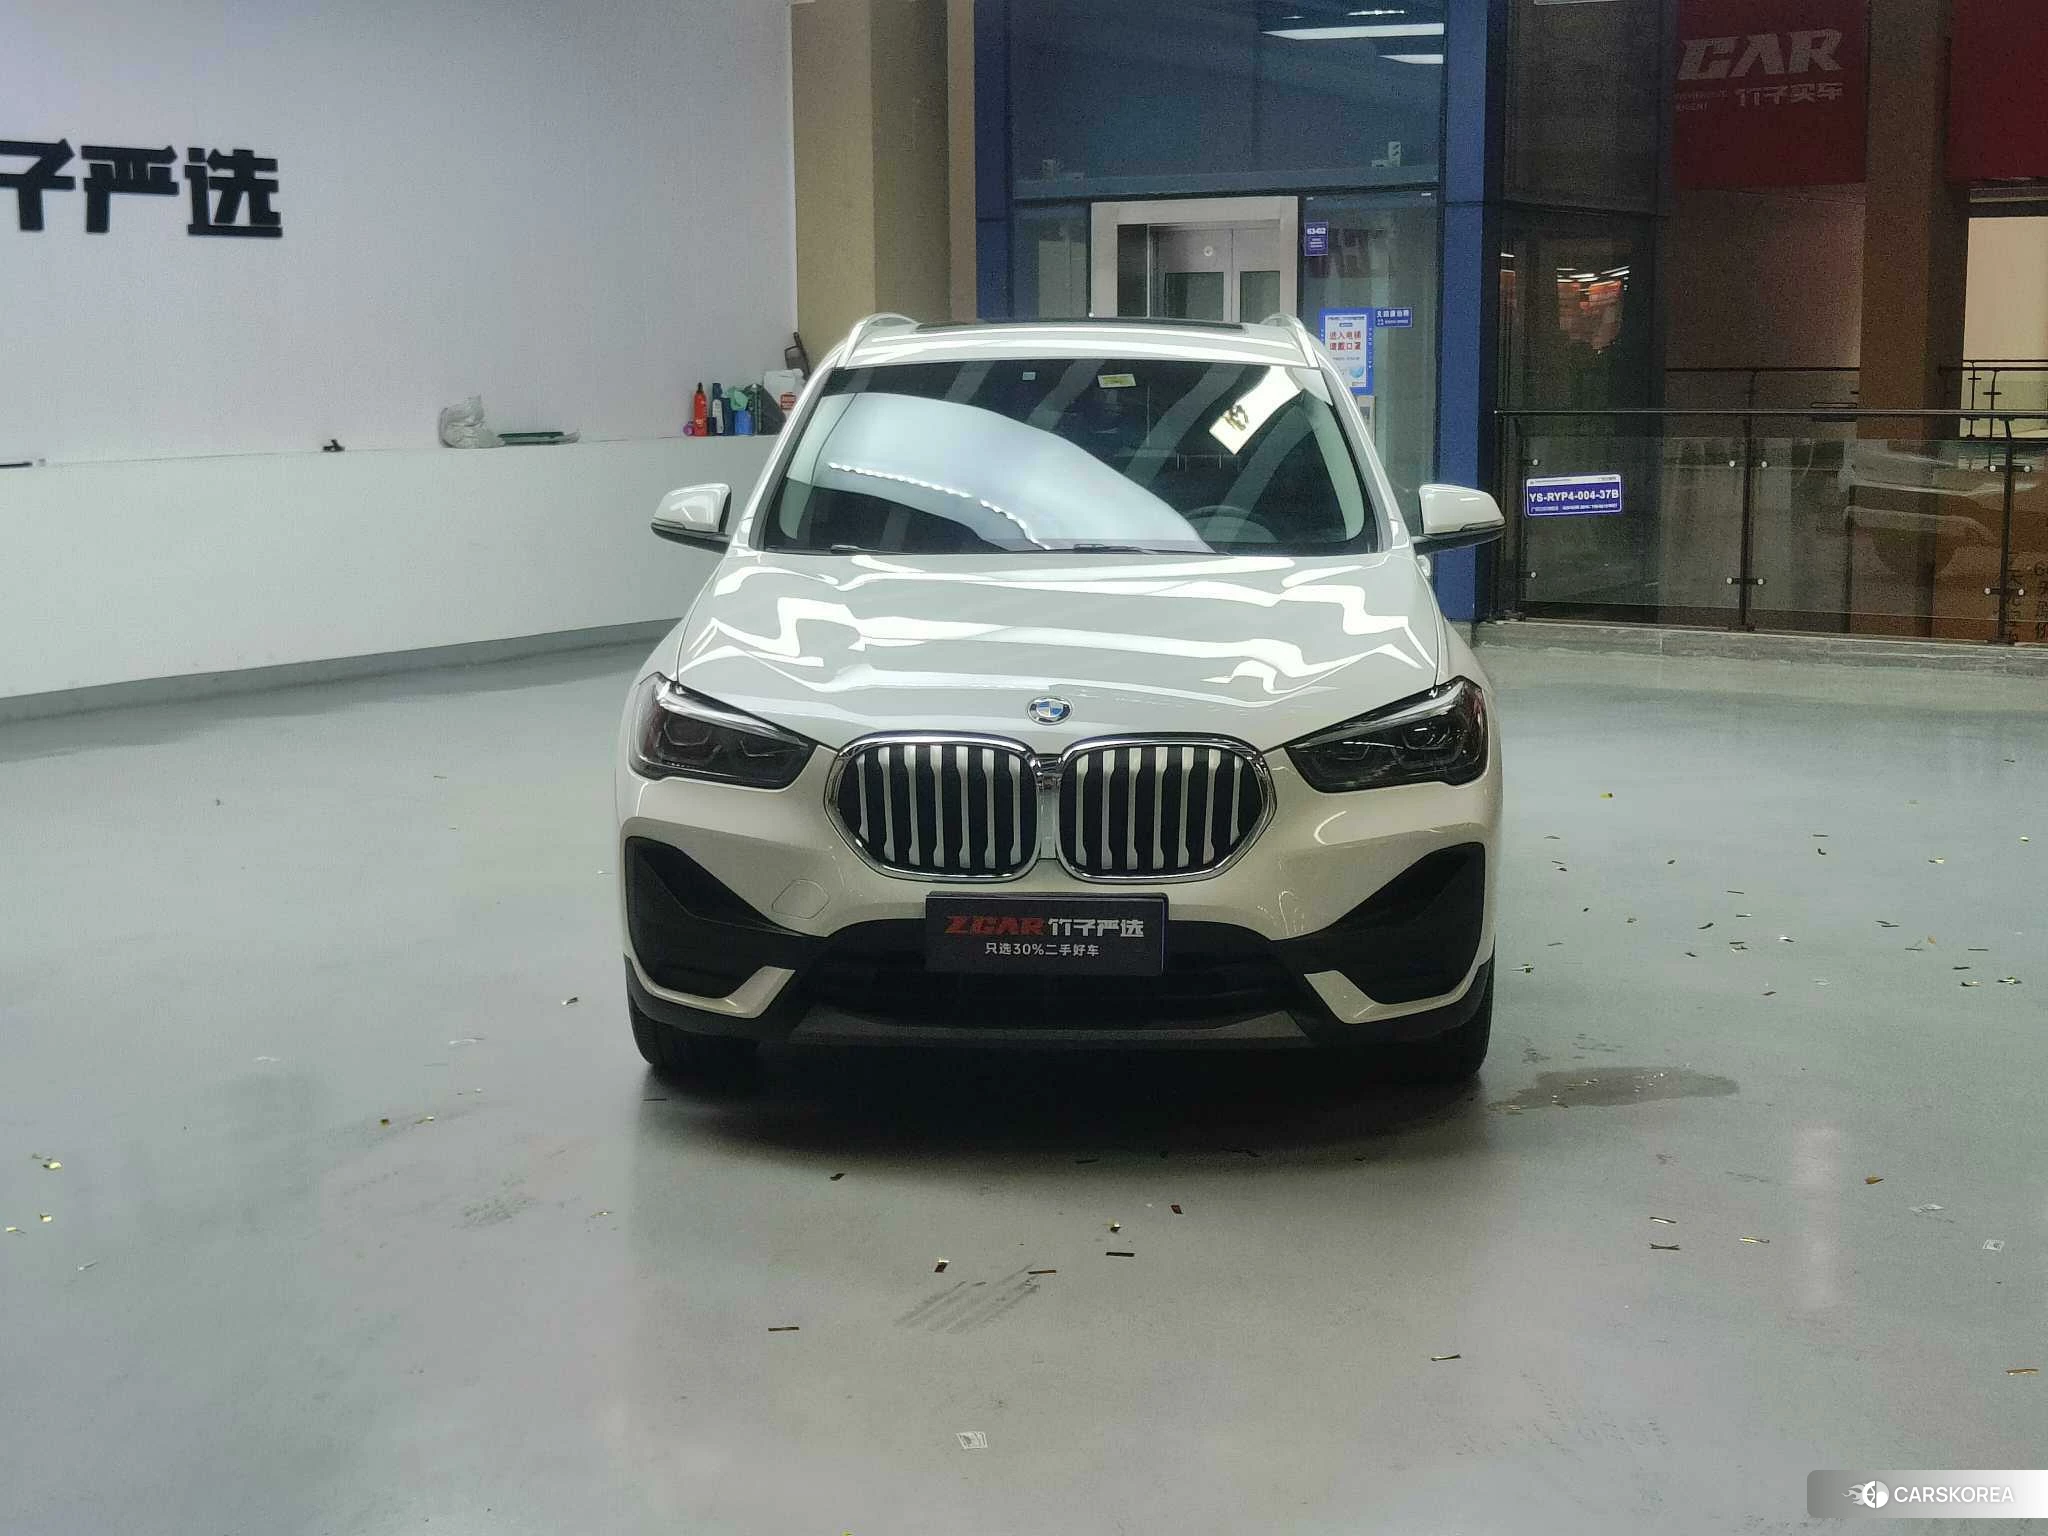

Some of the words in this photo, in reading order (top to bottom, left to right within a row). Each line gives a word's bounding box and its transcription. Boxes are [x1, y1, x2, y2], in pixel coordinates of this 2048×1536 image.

[0, 138, 283, 238] 子严选
[1529, 489, 1619, 503] YS-RYP4-004-37B
[945, 916, 1044, 935] ZCAR
[1047, 917, 1145, 938] 竹子严选
[984, 942, 1100, 957] 只选30%二手好车
